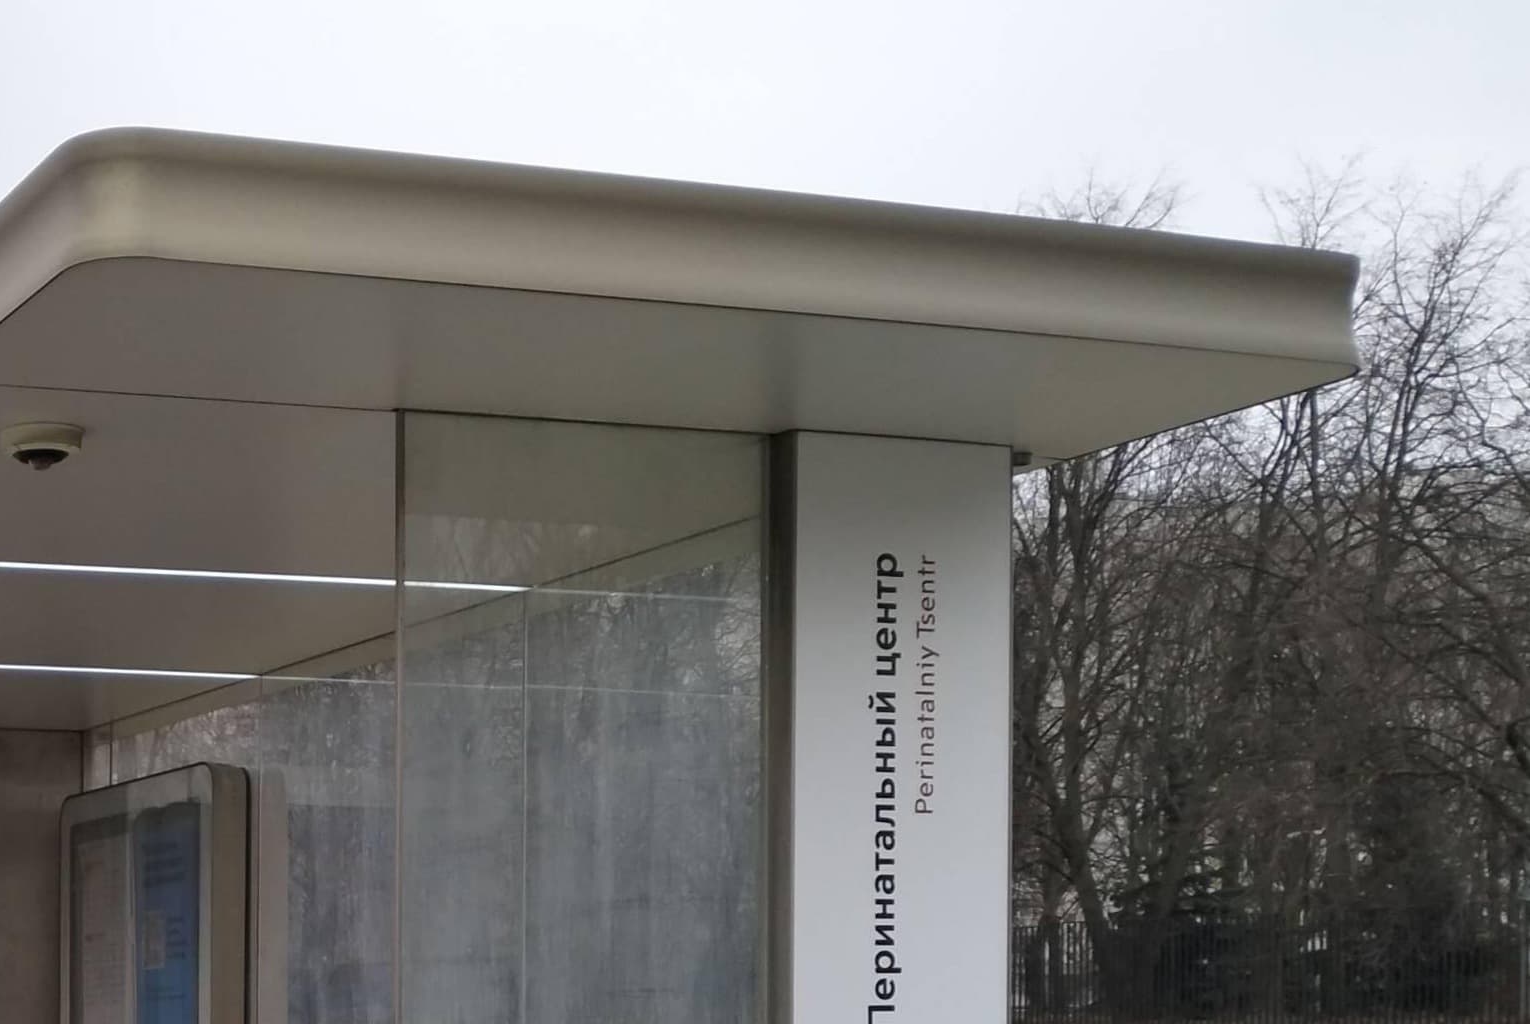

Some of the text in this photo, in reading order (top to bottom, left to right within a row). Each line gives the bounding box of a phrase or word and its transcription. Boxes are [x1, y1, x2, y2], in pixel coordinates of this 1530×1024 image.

[875, 552, 904, 677] центр
[914, 555, 940, 815] Perinatalniy Tsentr
